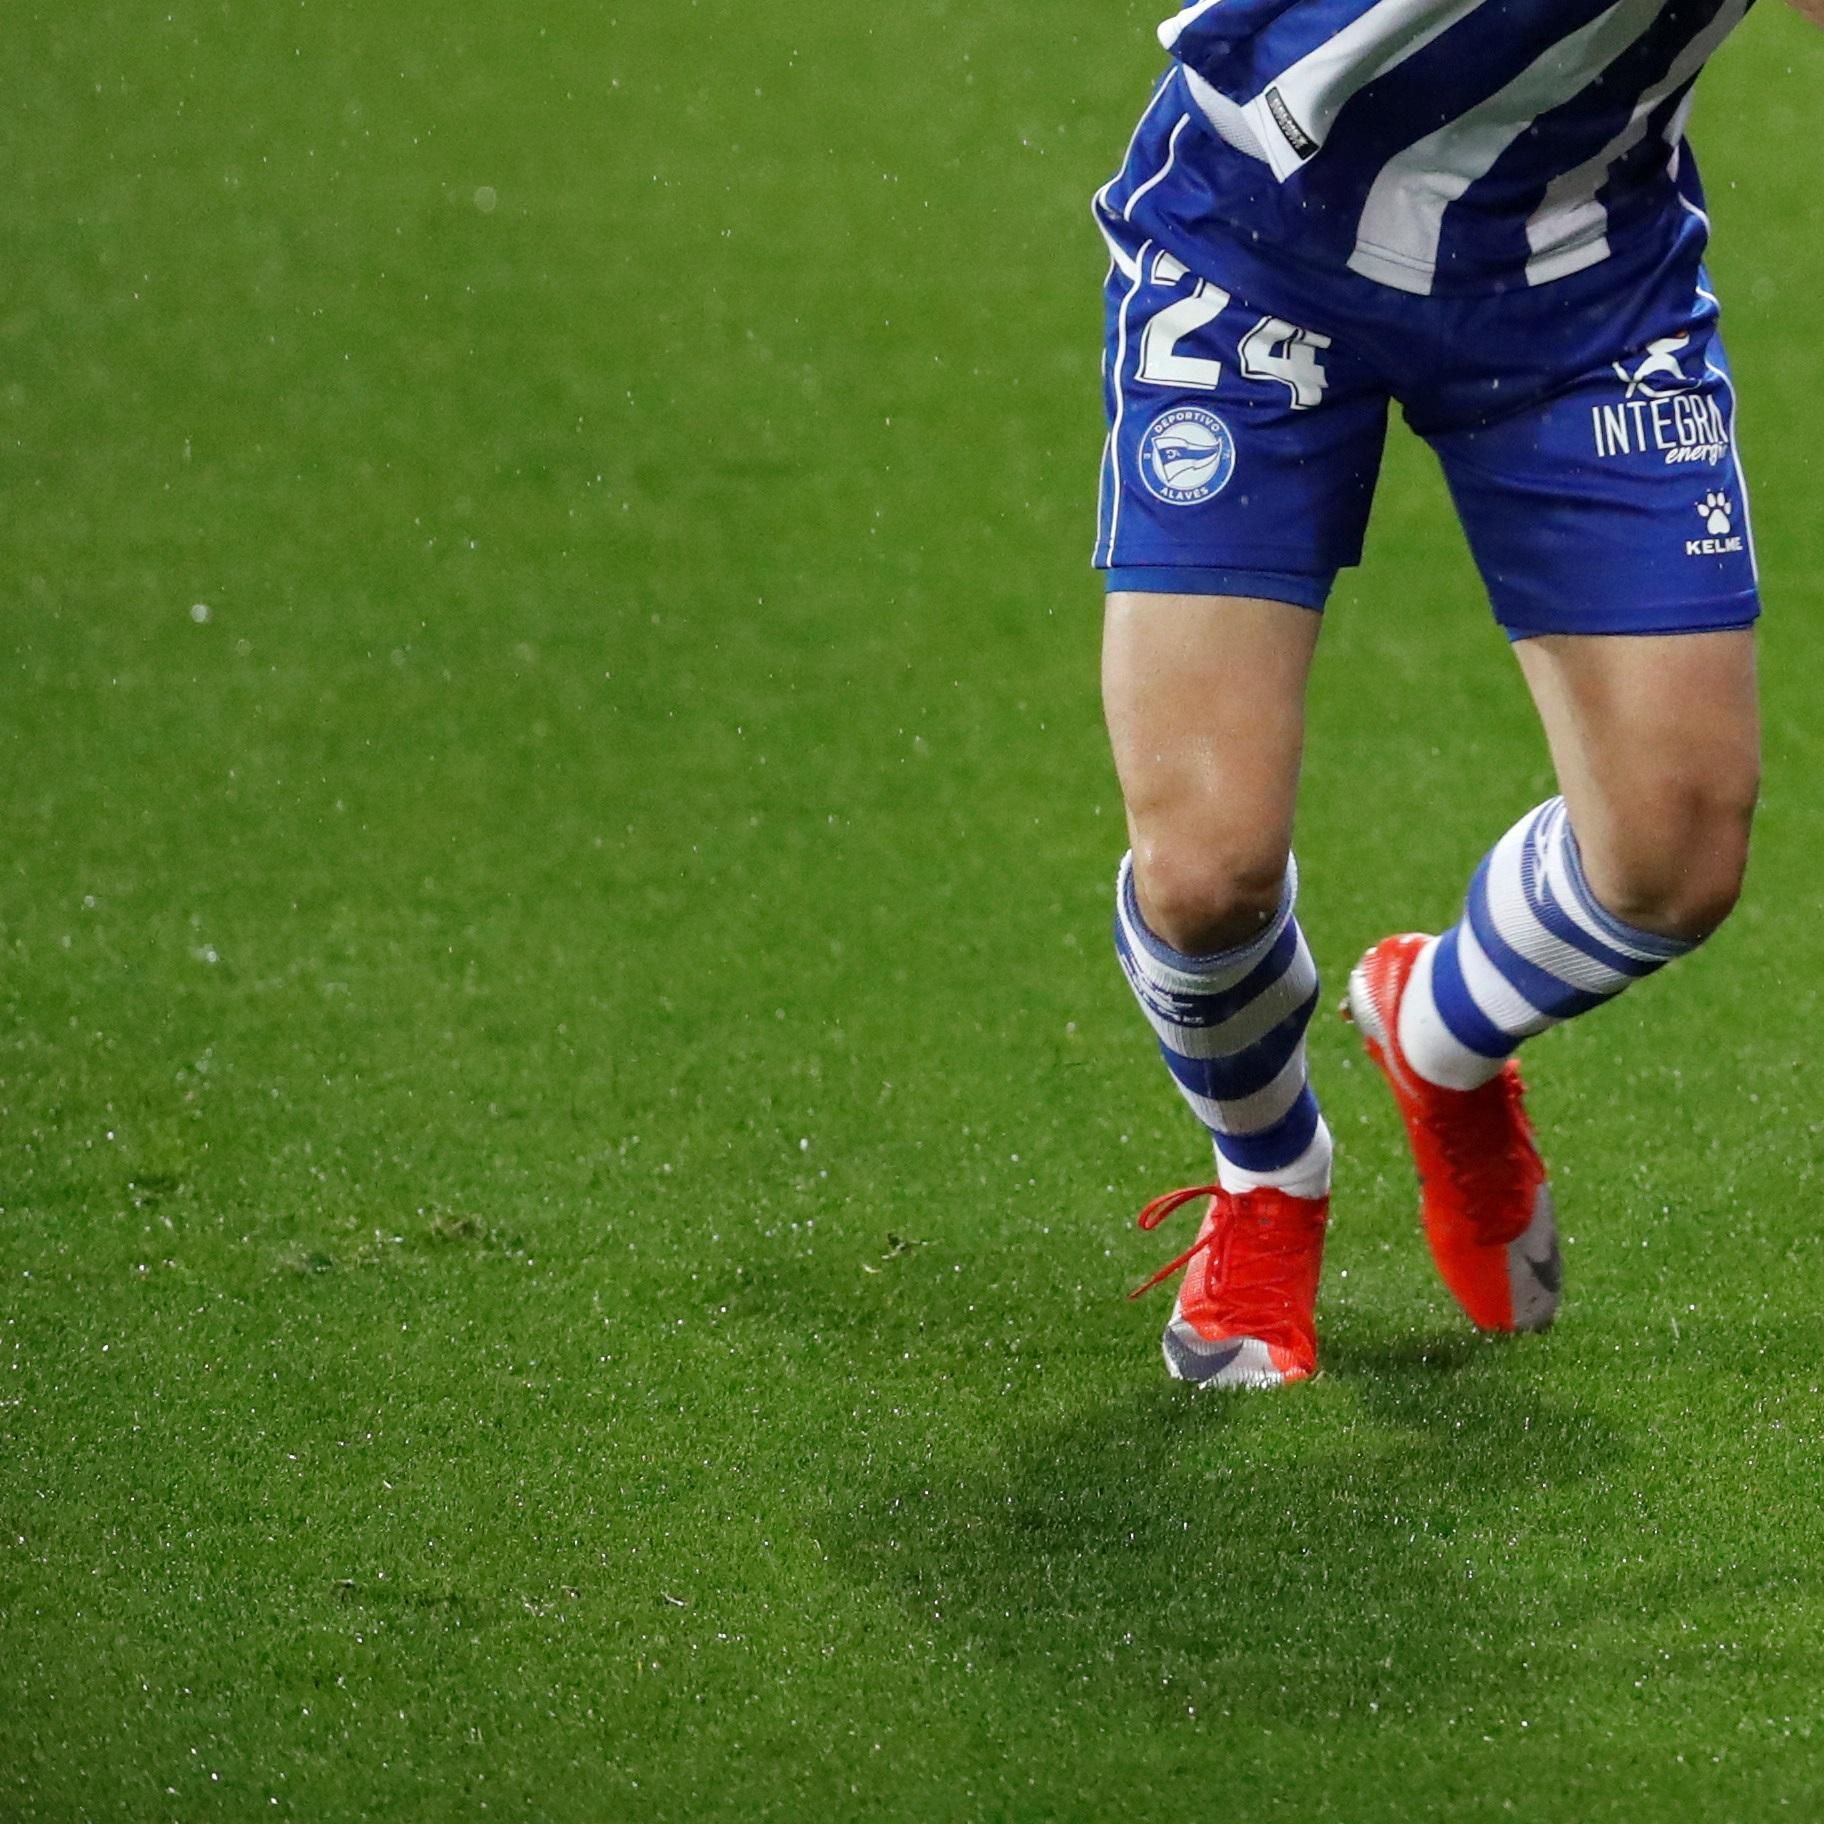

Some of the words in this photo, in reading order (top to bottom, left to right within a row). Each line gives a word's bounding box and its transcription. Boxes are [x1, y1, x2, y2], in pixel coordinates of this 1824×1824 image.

[1134, 248, 1332, 411] 24
[1154, 411, 1221, 434] DEPORTIVO
[1592, 393, 1729, 458] INTEGRA
[1664, 440, 1728, 467] energi
[1685, 536, 1743, 556] KELME
